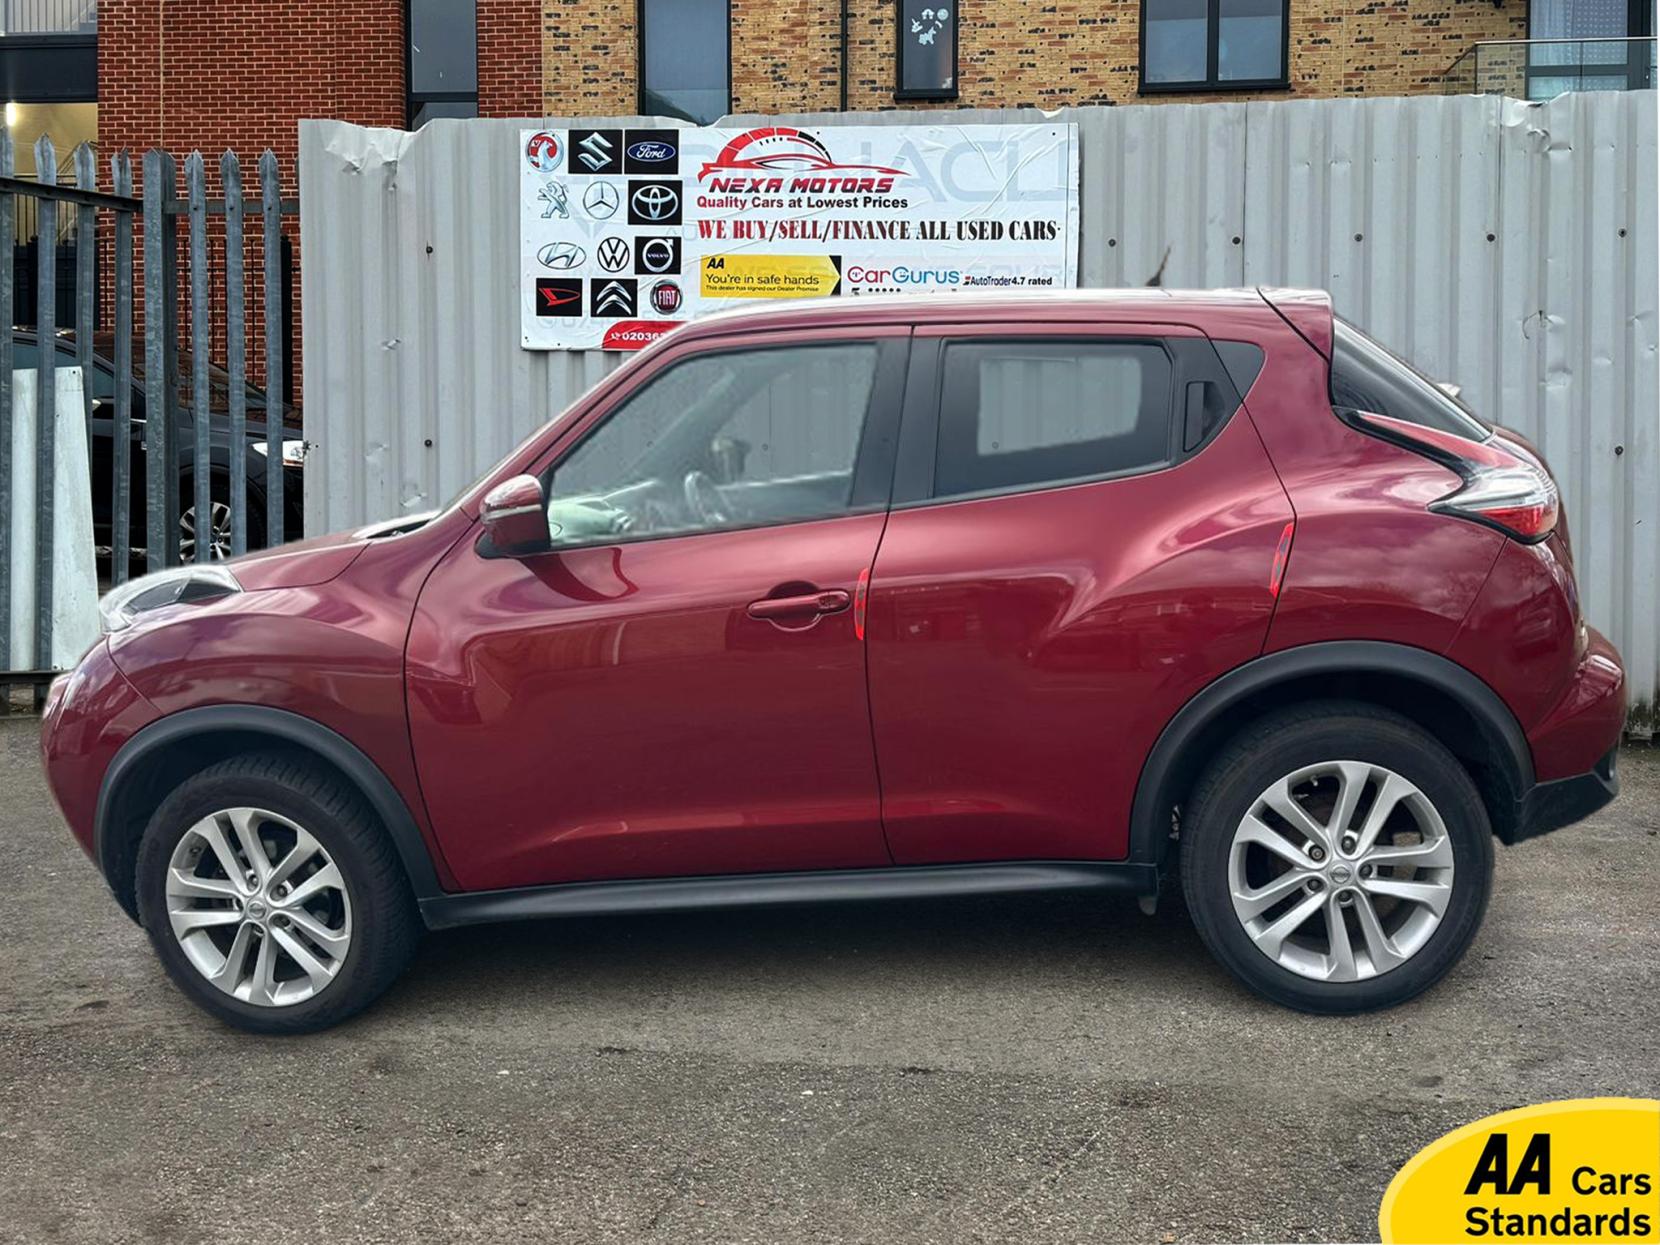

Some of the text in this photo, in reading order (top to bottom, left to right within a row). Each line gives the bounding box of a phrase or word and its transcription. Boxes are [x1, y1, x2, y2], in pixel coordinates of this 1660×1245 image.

[636, 144, 666, 159] Ford
[709, 177, 894, 194] NEXA MOTORS
[697, 195, 908, 211] Quality Cars at Lowest Prices
[698, 219, 727, 240] WE
[916, 220, 951, 240] ALL
[957, 220, 1004, 241] USED
[1008, 220, 1057, 241] CARS
[706, 257, 725, 270] AA
[705, 273, 820, 285] You're in safe hands
[847, 265, 960, 284] CarGurus
[1028, 276, 1053, 286] rated
[658, 290, 676, 306] FIAT
